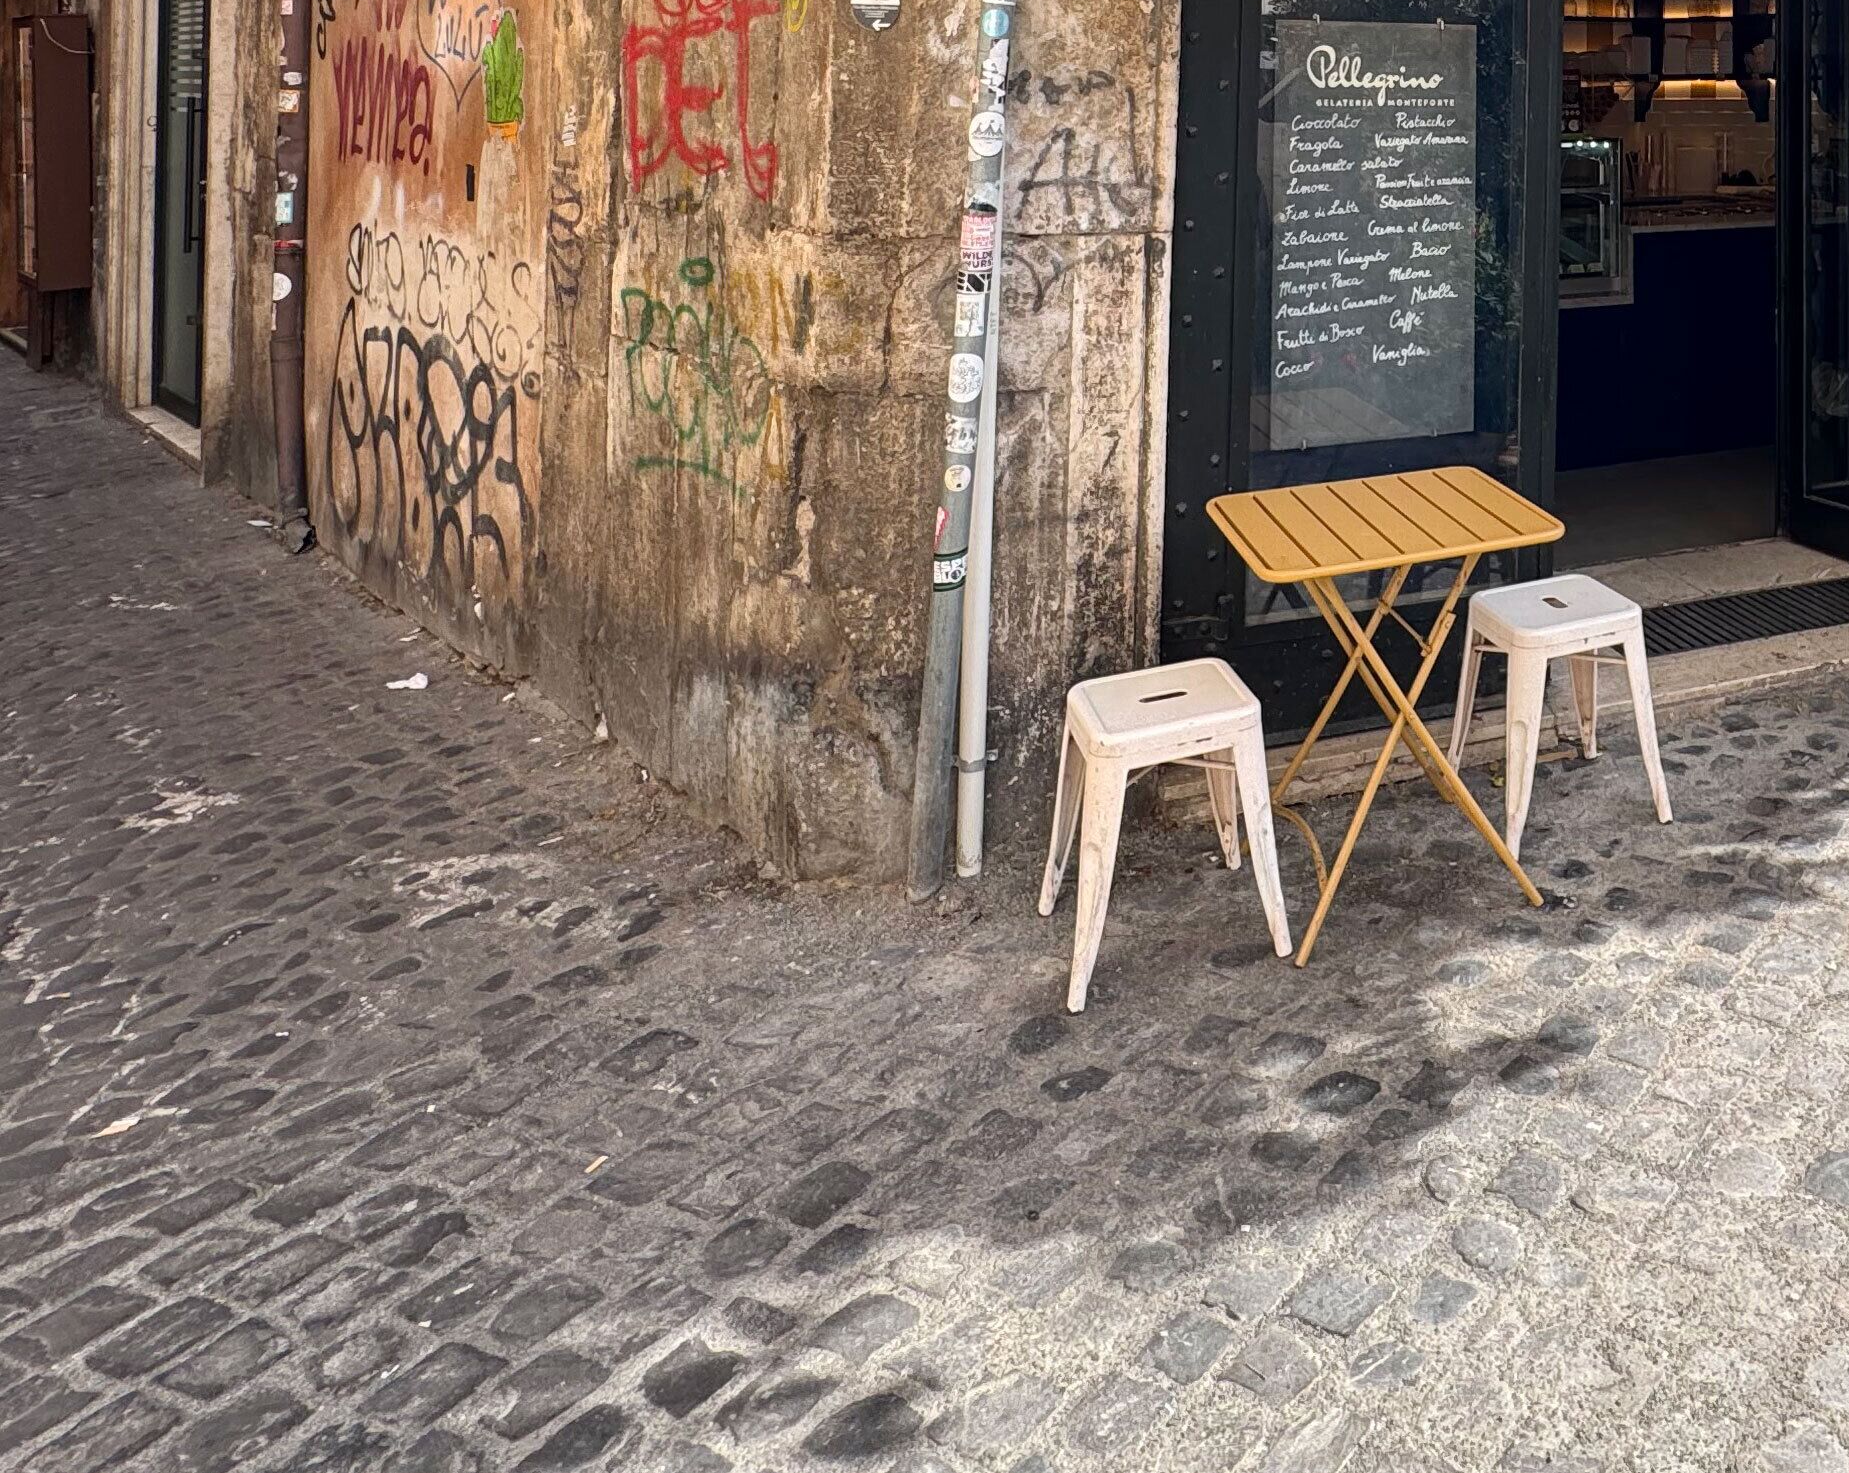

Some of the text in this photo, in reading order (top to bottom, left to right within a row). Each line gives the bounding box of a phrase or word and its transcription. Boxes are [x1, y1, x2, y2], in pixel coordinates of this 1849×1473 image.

[1306, 44, 1444, 107] Pellegrino
[1315, 98, 1455, 107] GELATERIA MONTEFORTE
[1292, 113, 1361, 131] Cioccolato
[1395, 111, 1456, 129] Pistacchio
[1289, 136, 1344, 158] Fragola
[1374, 132, 1422, 153] Variegato
[1289, 155, 1403, 175] Caramello salato
[1286, 177, 1334, 196] Limone
[1315, 205, 1326, 219] di
[1327, 199, 1360, 215] Latte
[1379, 193, 1456, 211] Stracciatella
[1367, 219, 1405, 237] Crema
[1421, 217, 1465, 233] limone
[1281, 230, 1349, 247] Zabaione
[1410, 241, 1452, 260] Bacio
[1277, 247, 1391, 275] Lampone Variegato
[1388, 266, 1433, 283] Melone
[1278, 280, 1320, 299] Mango
[1329, 272, 1366, 290] Pesca
[1410, 282, 1459, 306] Nutella
[1275, 301, 1332, 321] Arachidi
[1277, 323, 1366, 351] Frutti di Bosco
[1372, 342, 1428, 367] Vaniglia
[1275, 360, 1315, 379] Cocco
